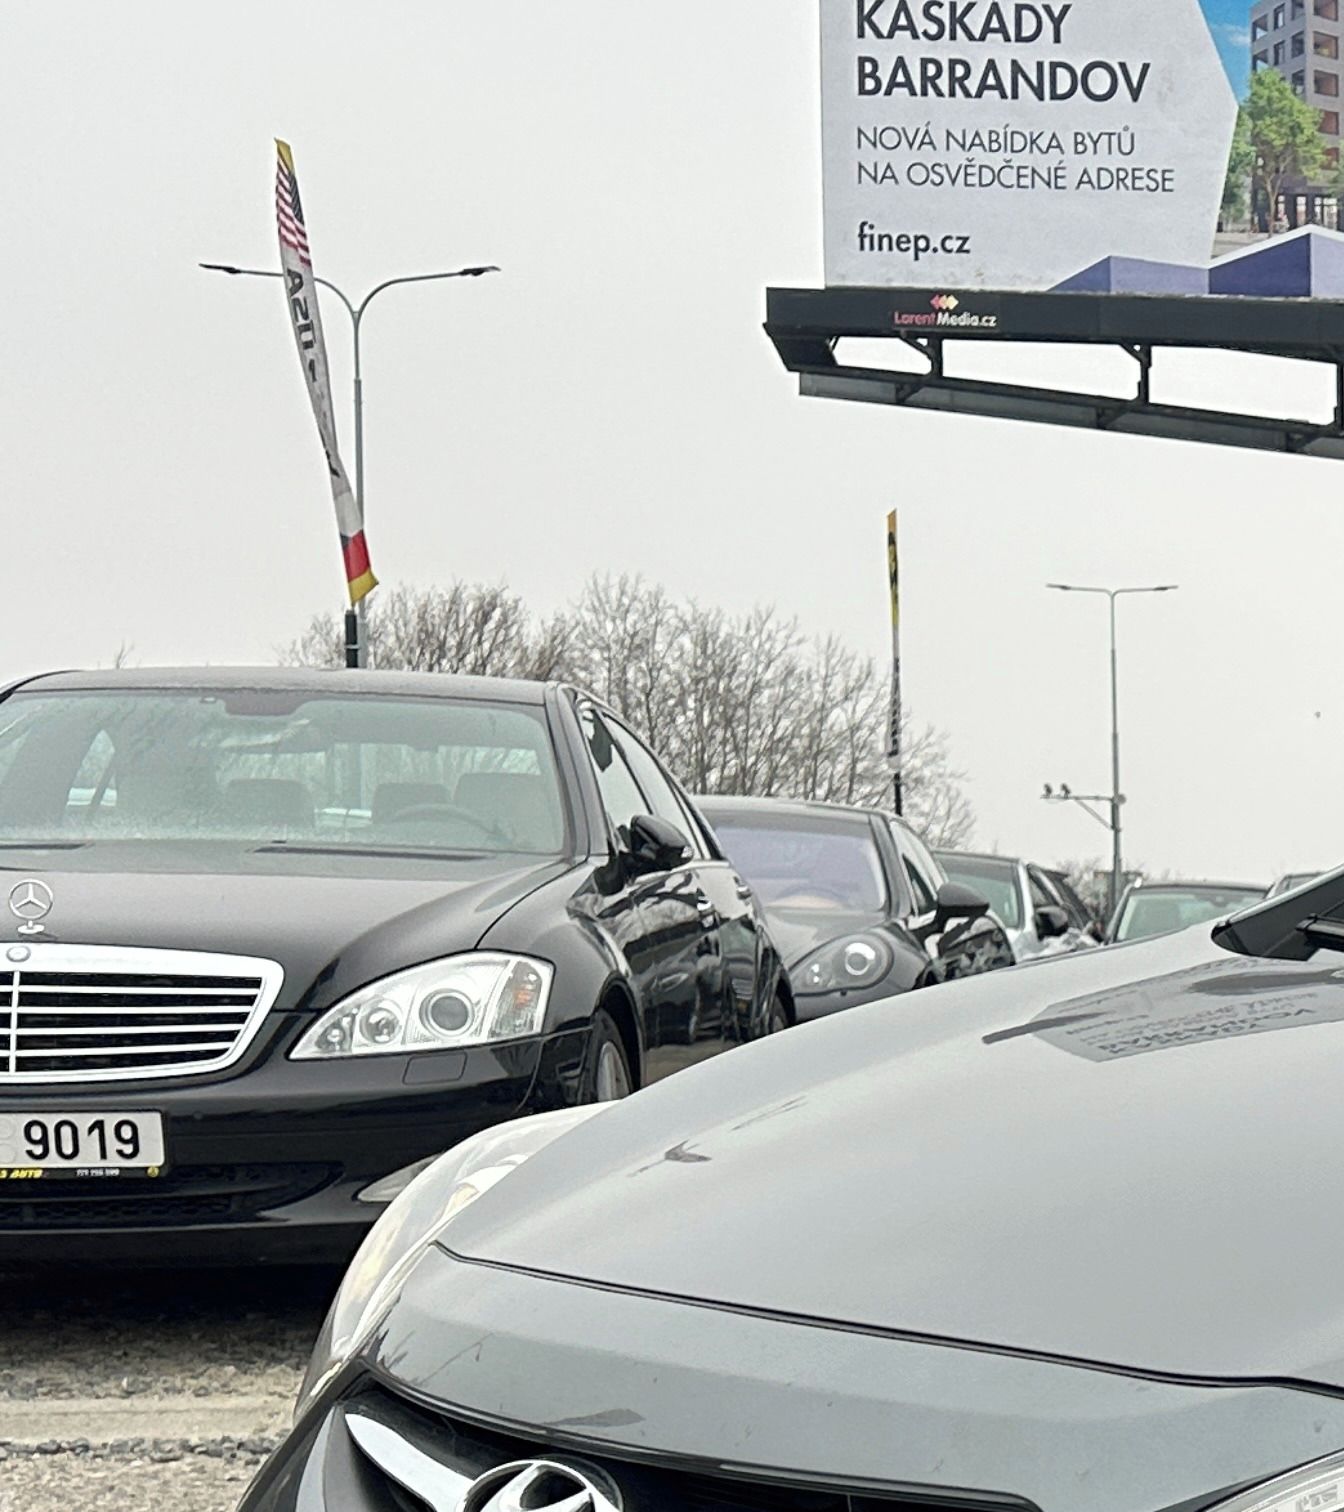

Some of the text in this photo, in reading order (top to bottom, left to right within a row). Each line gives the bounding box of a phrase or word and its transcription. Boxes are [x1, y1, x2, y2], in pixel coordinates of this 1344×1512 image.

[856, 55, 1151, 103] BARRANDOV
[856, 121, 1135, 156] NOVÁ NABÍDKA BYTŮ
[857, 157, 1175, 193] NA OSVĚDČENÉ ADRESE
[857, 220, 971, 262] finep.cz
[23, 1119, 140, 1160] 9019
